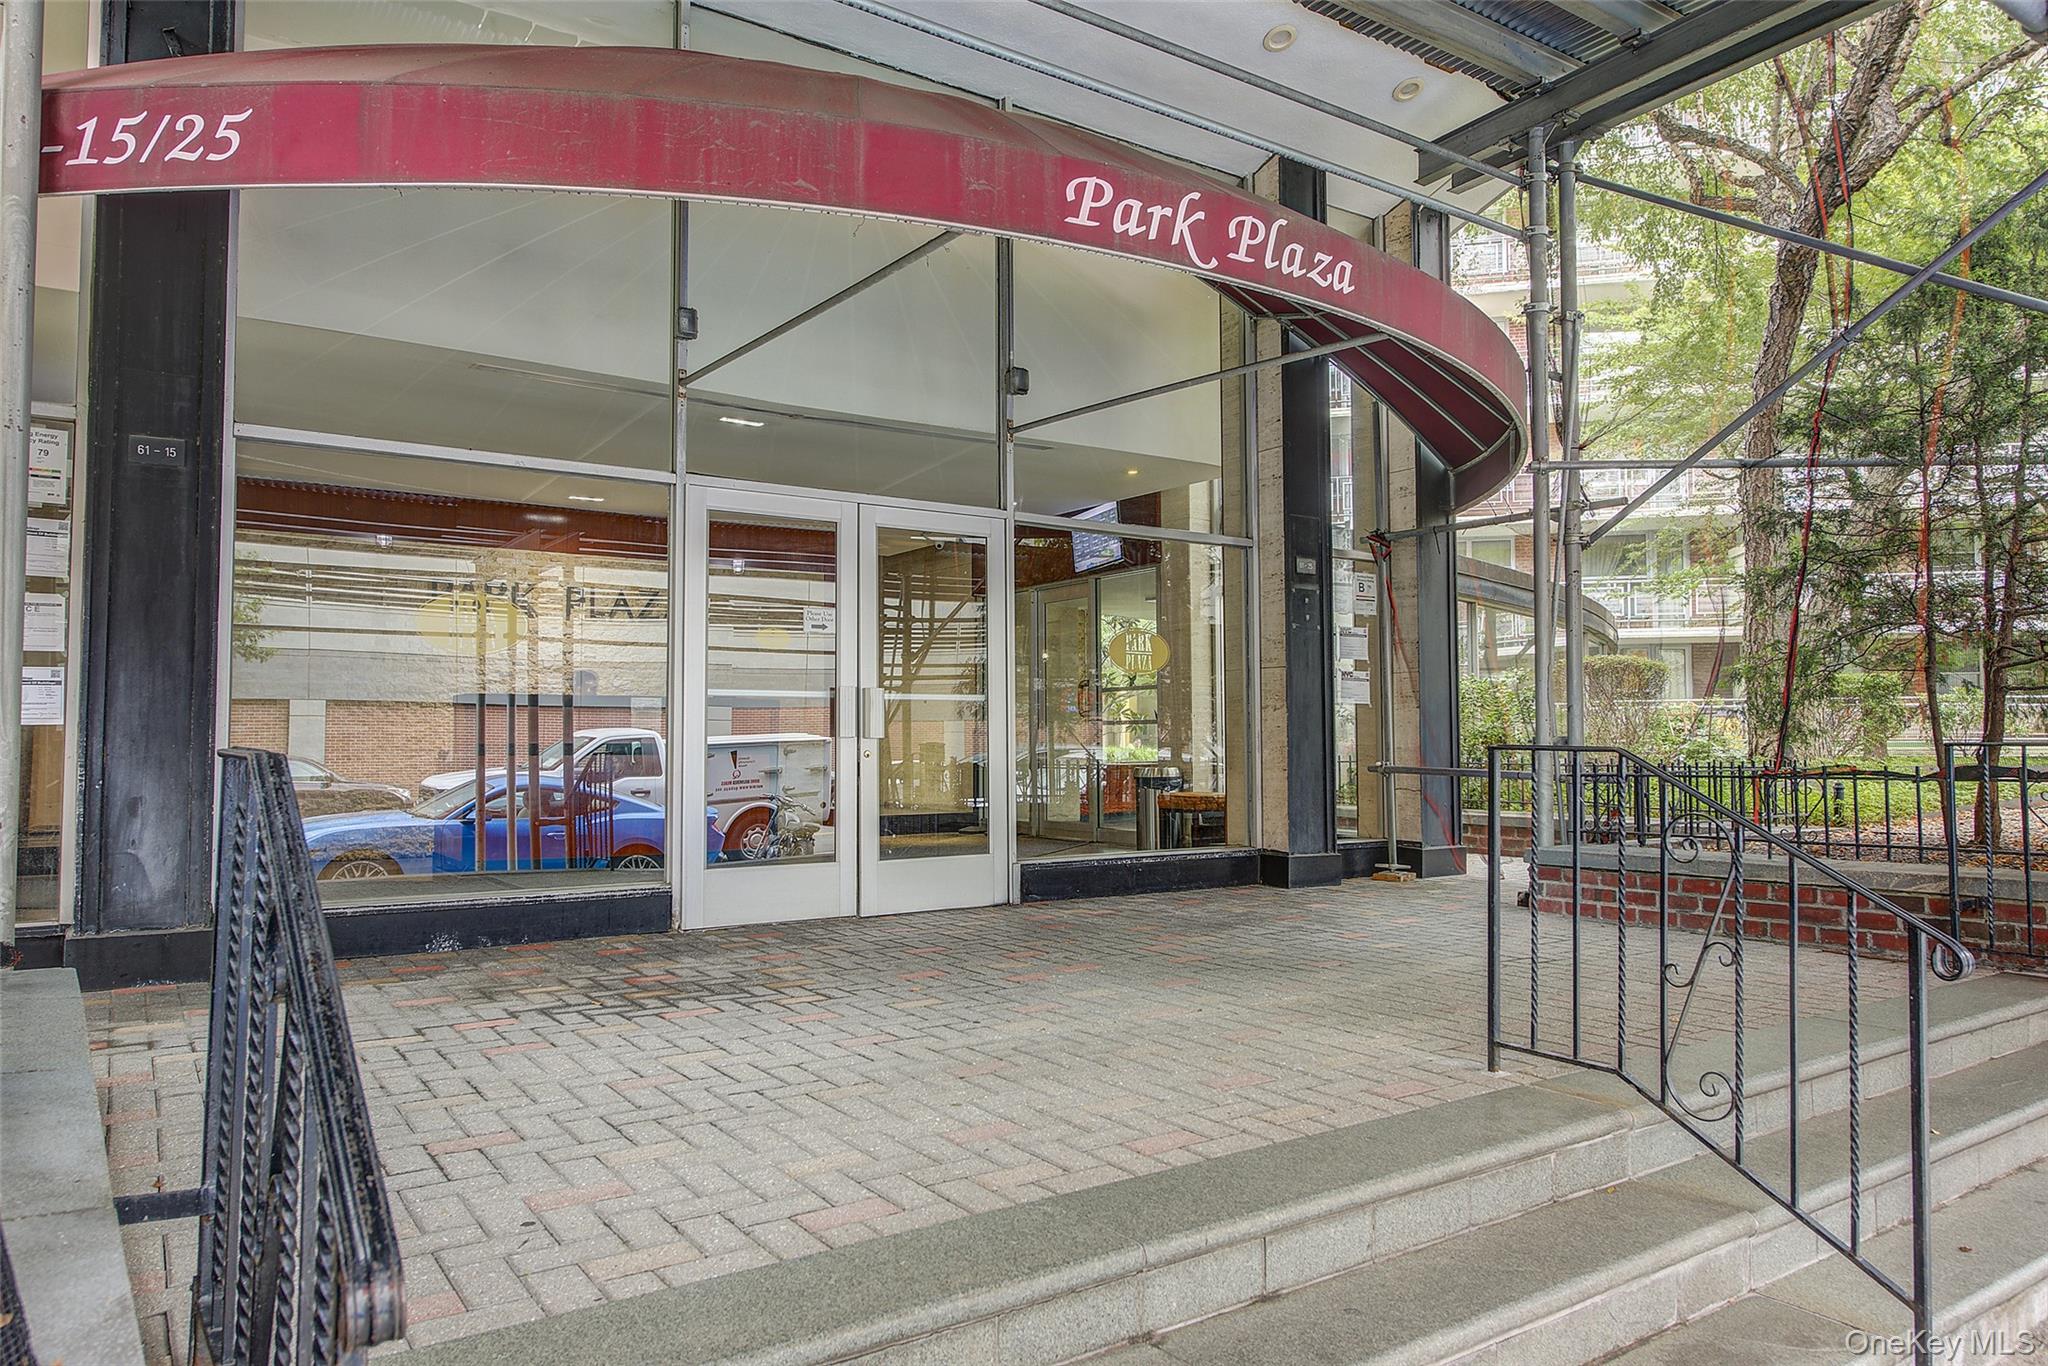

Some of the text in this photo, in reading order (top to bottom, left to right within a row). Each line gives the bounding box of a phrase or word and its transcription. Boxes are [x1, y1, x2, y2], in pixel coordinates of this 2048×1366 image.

[1064, 176, 1355, 294] Park Plaza
[37, 448, 49, 457] 79
[137, 444, 150, 456] 61
[165, 447, 177, 457] 15
[1358, 582, 1365, 592] B
[565, 586, 668, 620] PLAZ
[1125, 633, 1152, 651] PARK
